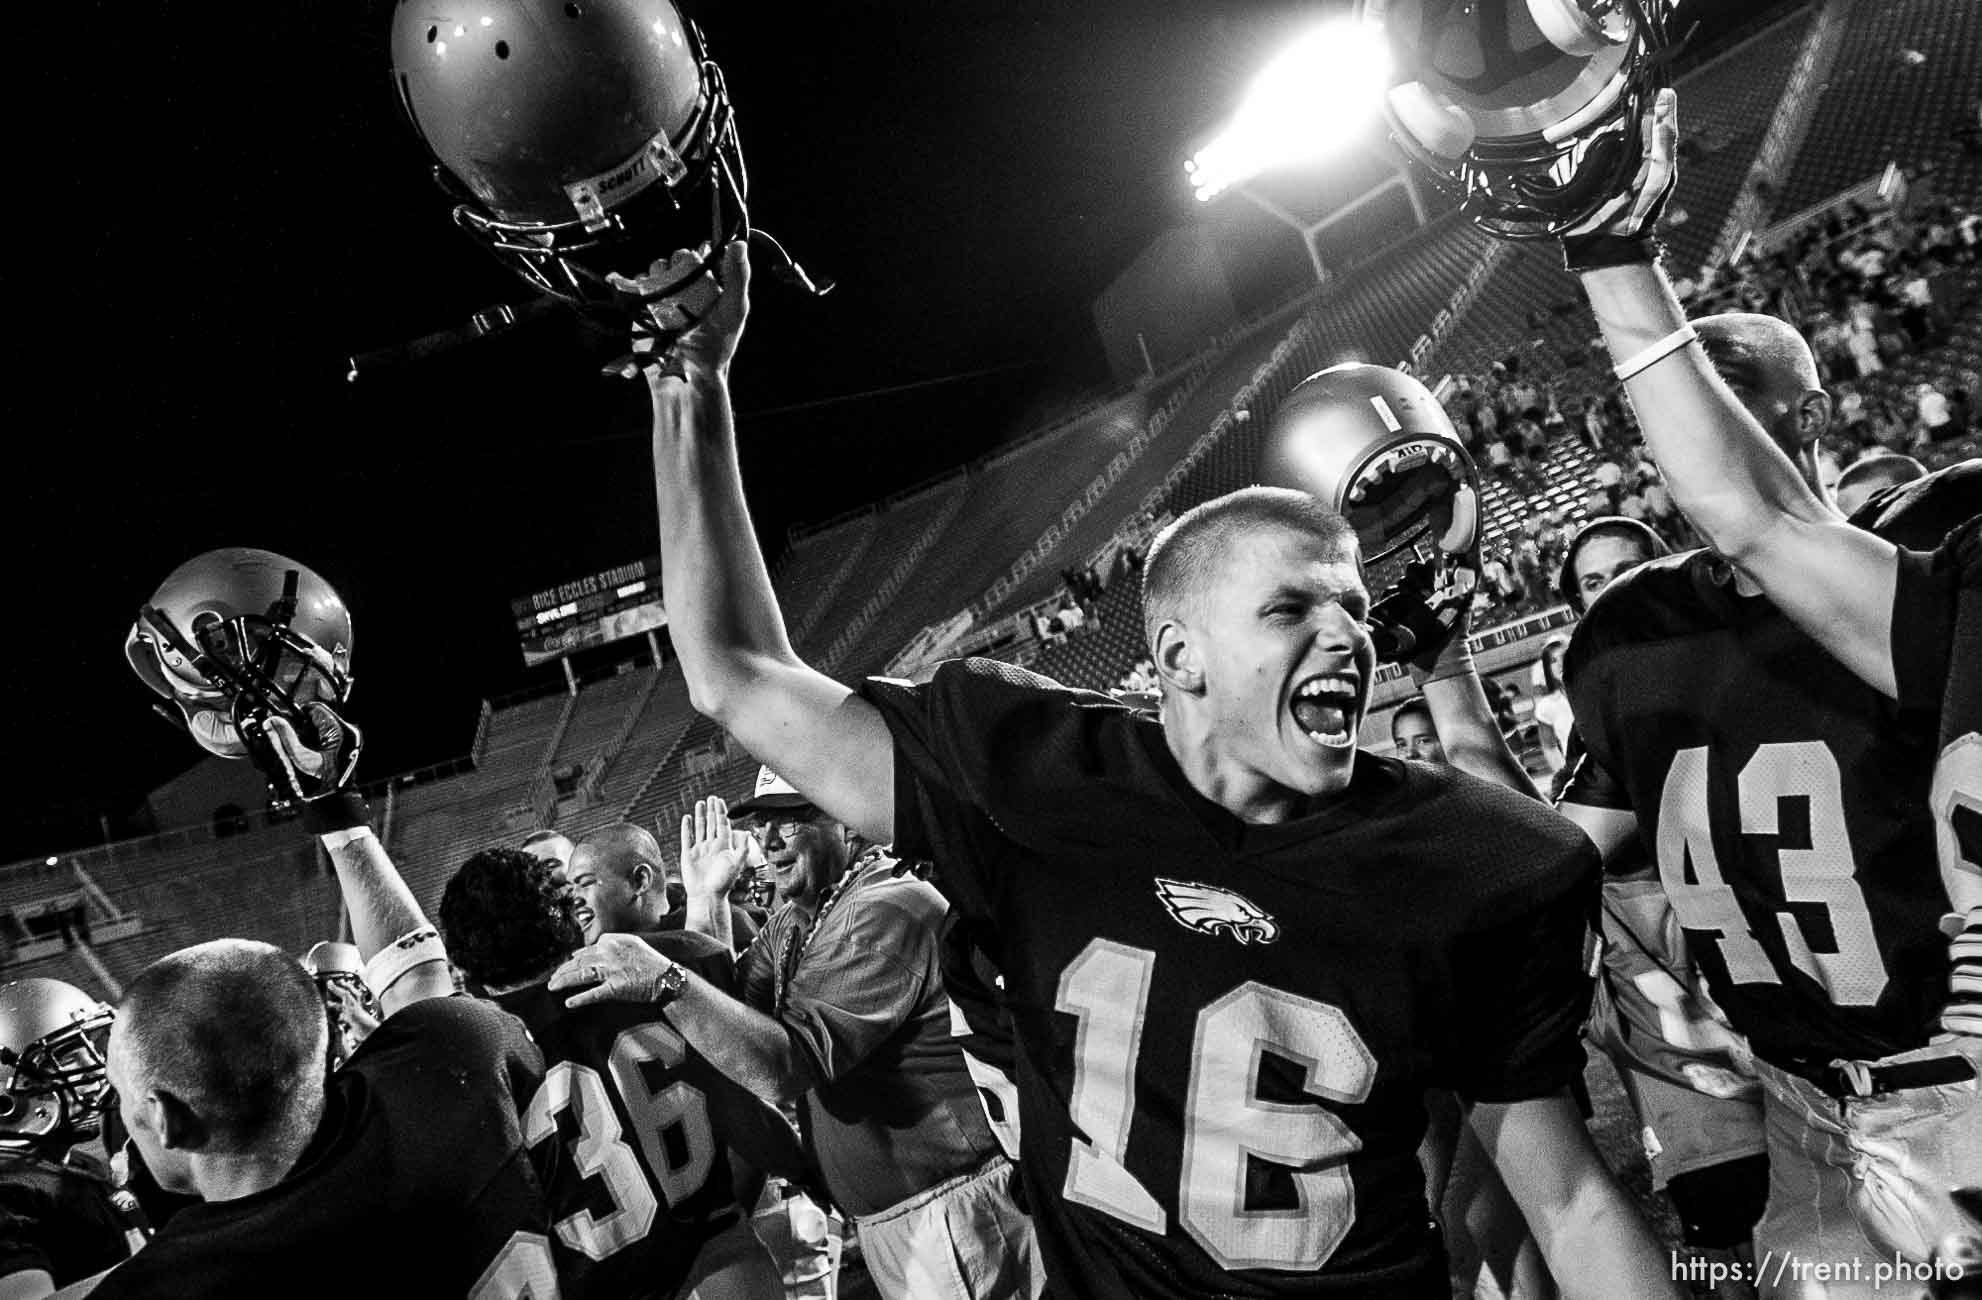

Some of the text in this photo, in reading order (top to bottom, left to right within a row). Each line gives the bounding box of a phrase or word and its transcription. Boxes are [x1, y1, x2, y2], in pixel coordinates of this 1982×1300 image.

[532, 588, 556, 610] RICE
[558, 576, 598, 602] ECCLES
[599, 560, 646, 588] STADIUM
[1656, 740, 1889, 1006] 43
[521, 1022, 716, 1261] 36
[1055, 937, 1378, 1271] 16
